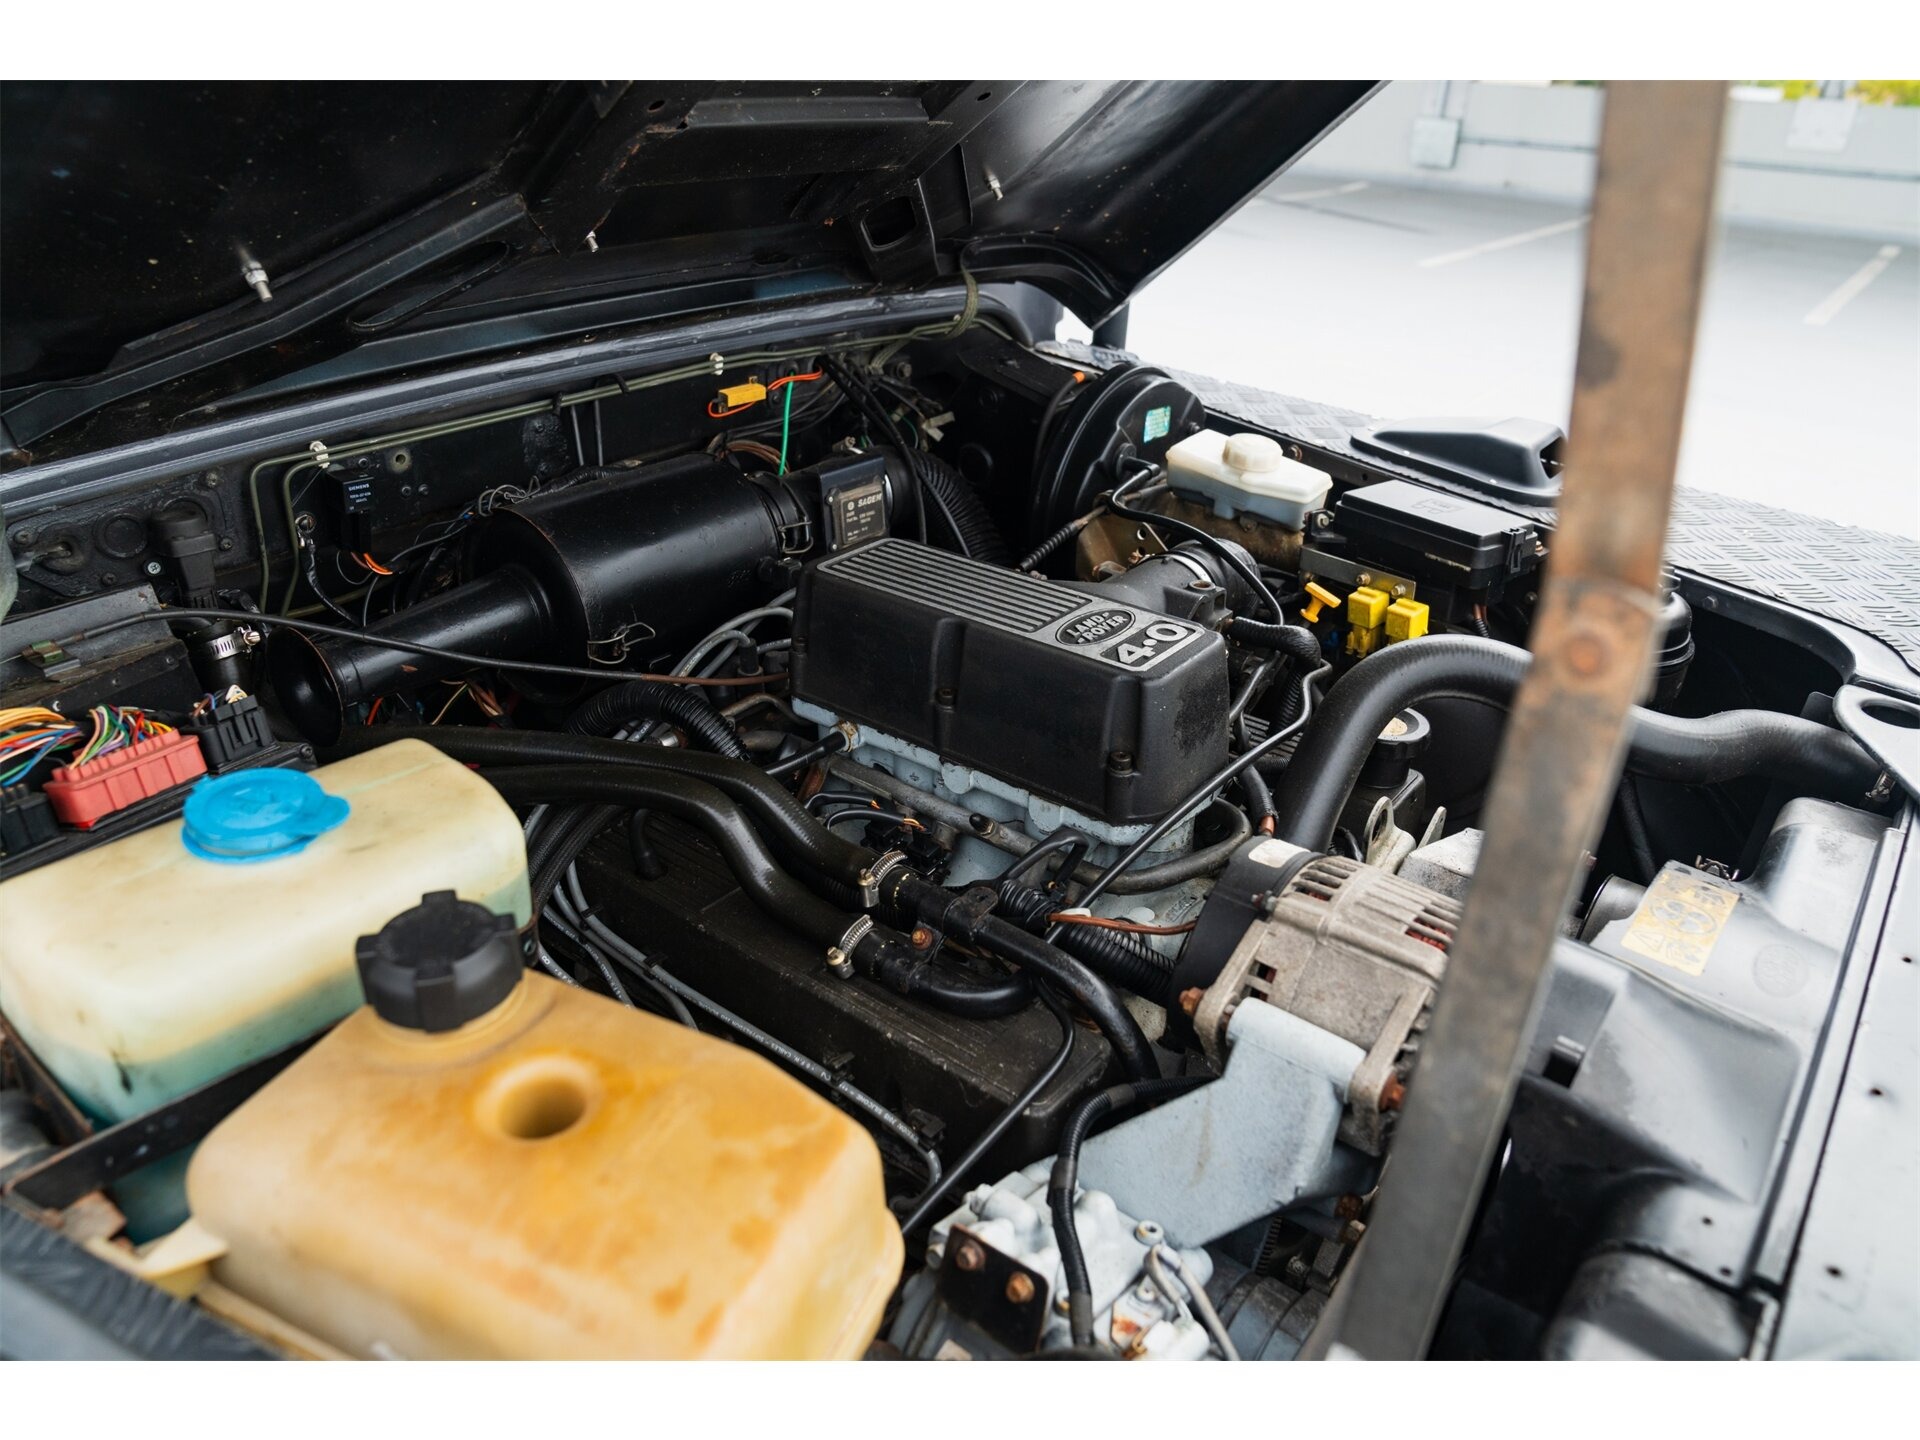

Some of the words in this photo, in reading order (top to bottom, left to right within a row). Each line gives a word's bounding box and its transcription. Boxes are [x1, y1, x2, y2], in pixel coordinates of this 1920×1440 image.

[348, 483, 370, 491] SIEMENS
[857, 493, 882, 507] SAGEM
[1066, 614, 1103, 637] LAND
[1082, 615, 1128, 640] ROVER
